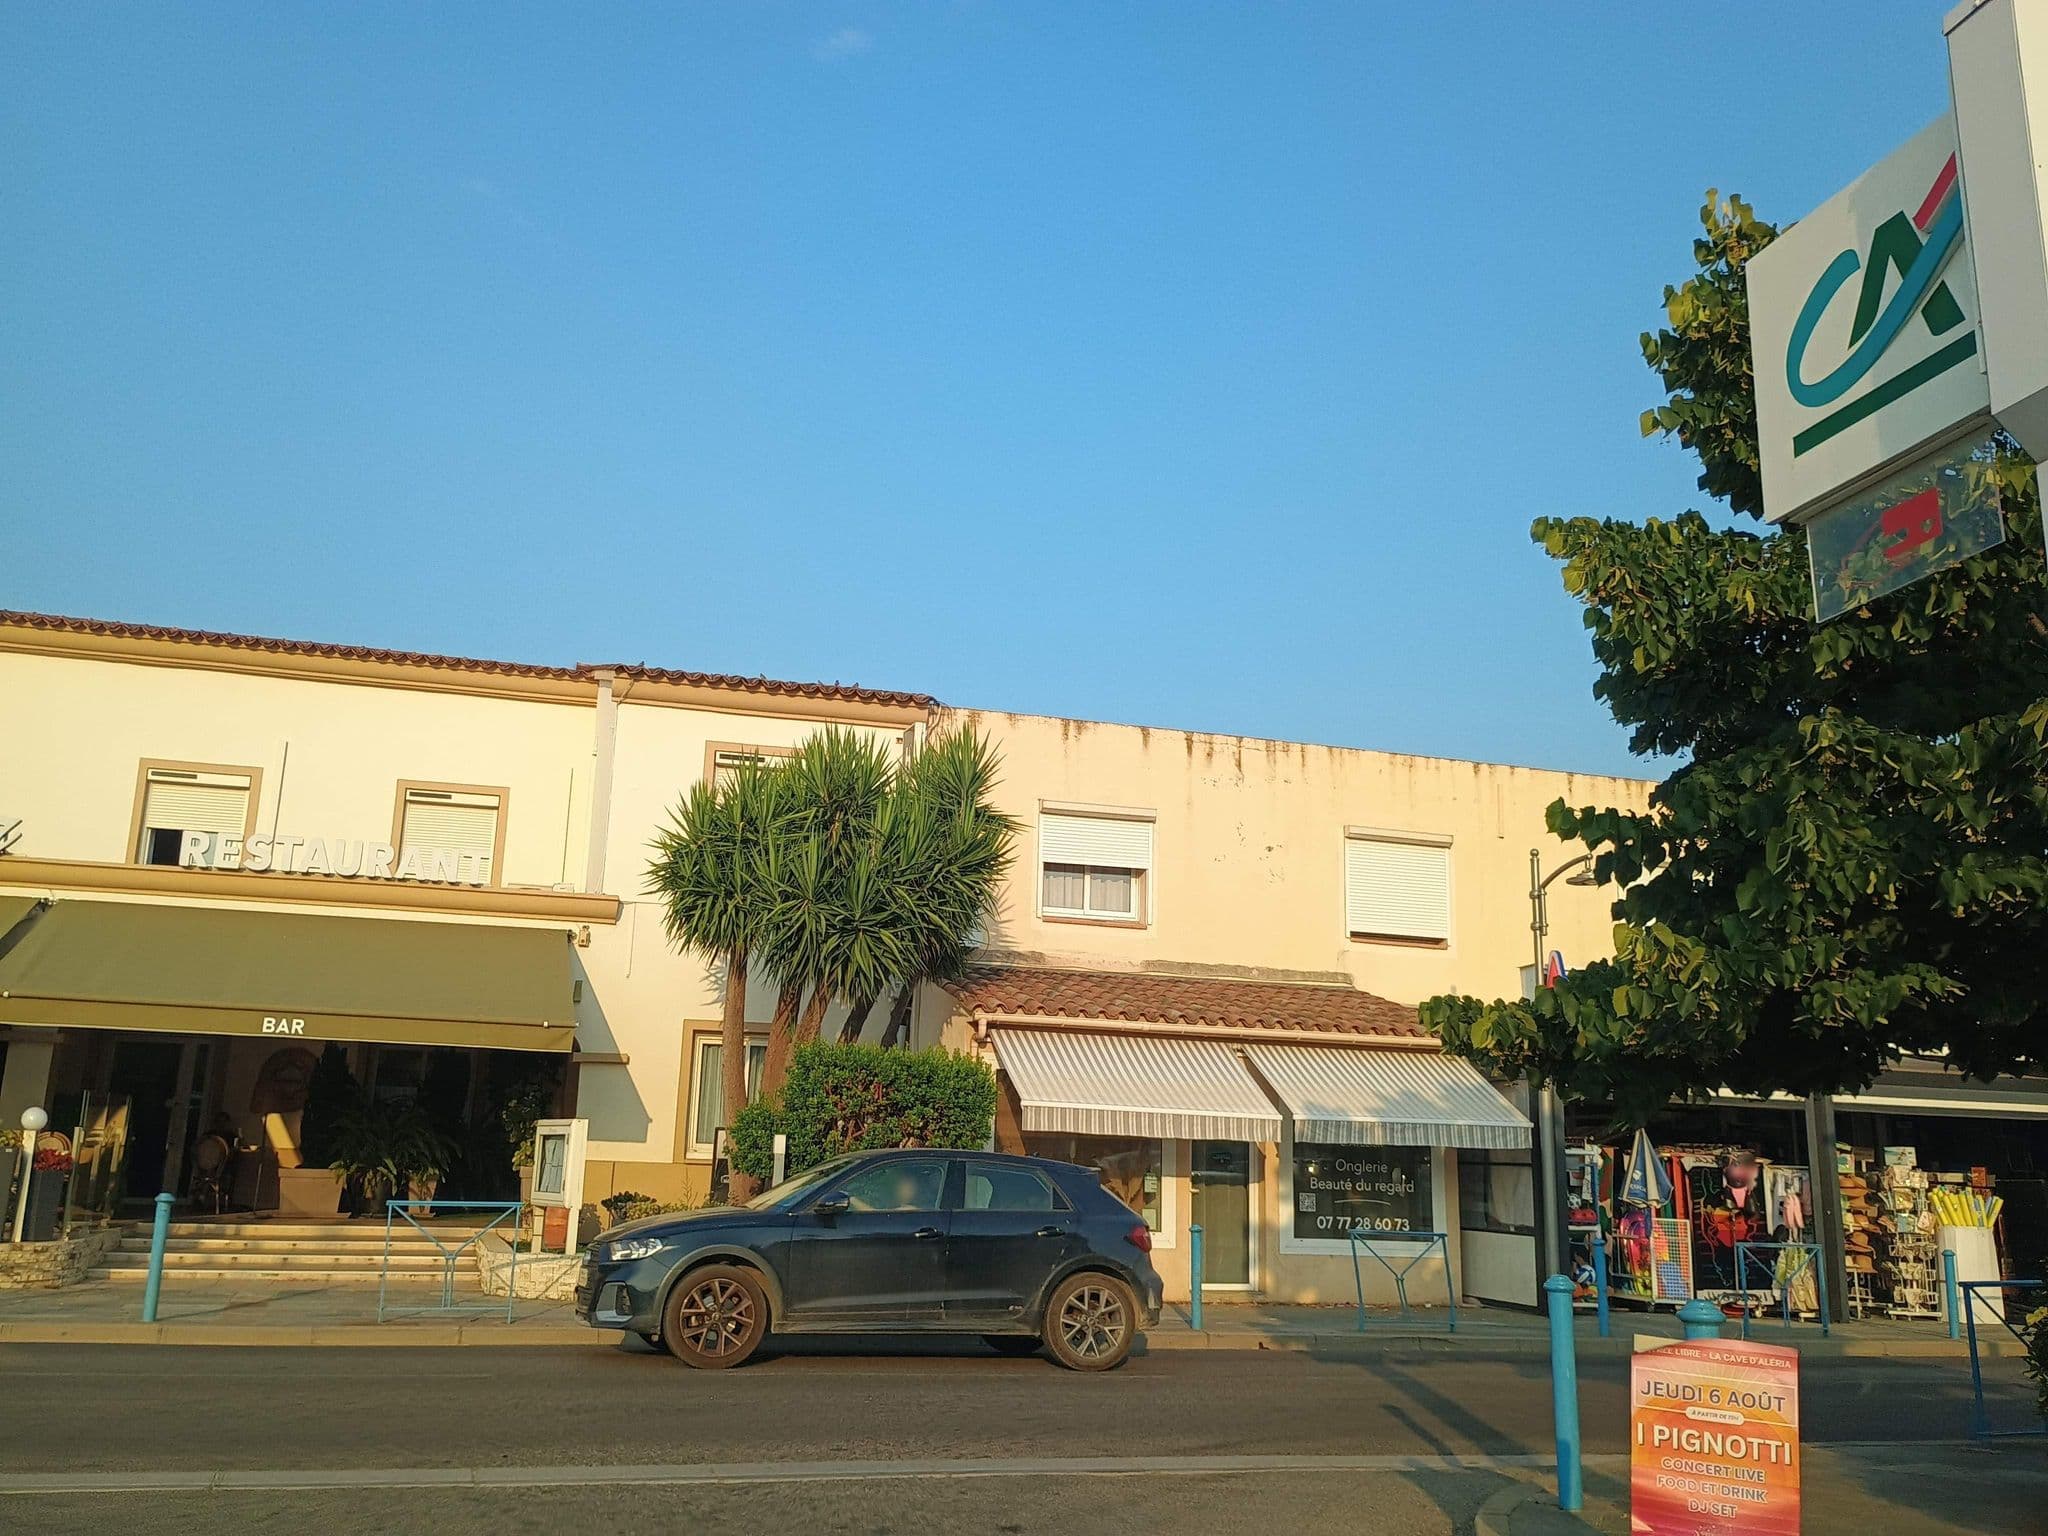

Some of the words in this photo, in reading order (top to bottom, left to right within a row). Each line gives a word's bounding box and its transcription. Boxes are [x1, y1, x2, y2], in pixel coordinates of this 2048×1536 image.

[179, 830, 490, 886] RESTAURANT
[262, 1017, 305, 1035] BAR
[1335, 1159, 1388, 1175] Onglerie
[1310, 1177, 1353, 1191] Beauté
[1356, 1179, 1372, 1192] du
[1375, 1180, 1415, 1196] regard
[1317, 1216, 1333, 1230] 07
[1336, 1216, 1351, 1230] 77
[1355, 1217, 1371, 1231] 28
[1375, 1217, 1392, 1231] 60
[1394, 1218, 1410, 1232] 73
[1675, 1348, 1701, 1358] LIBRE
[1709, 1351, 1722, 1361] LA
[1723, 1354, 1748, 1364] CAVE
[1641, 1380, 1702, 1402] JEUDI
[1709, 1389, 1720, 1404] 6
[1727, 1391, 1786, 1412] AOÛT
[1637, 1422, 1644, 1445] I
[1653, 1424, 1792, 1466] PIGNOTTI
[1662, 1458, 1731, 1479] CONCERT
[1735, 1467, 1765, 1483] LIVE
[1657, 1475, 1698, 1490] FOOD
[1701, 1483, 1718, 1495] ET
[1721, 1484, 1767, 1503] DRINK
[1689, 1500, 1707, 1514] DJ
[1710, 1503, 1737, 1518] SET
